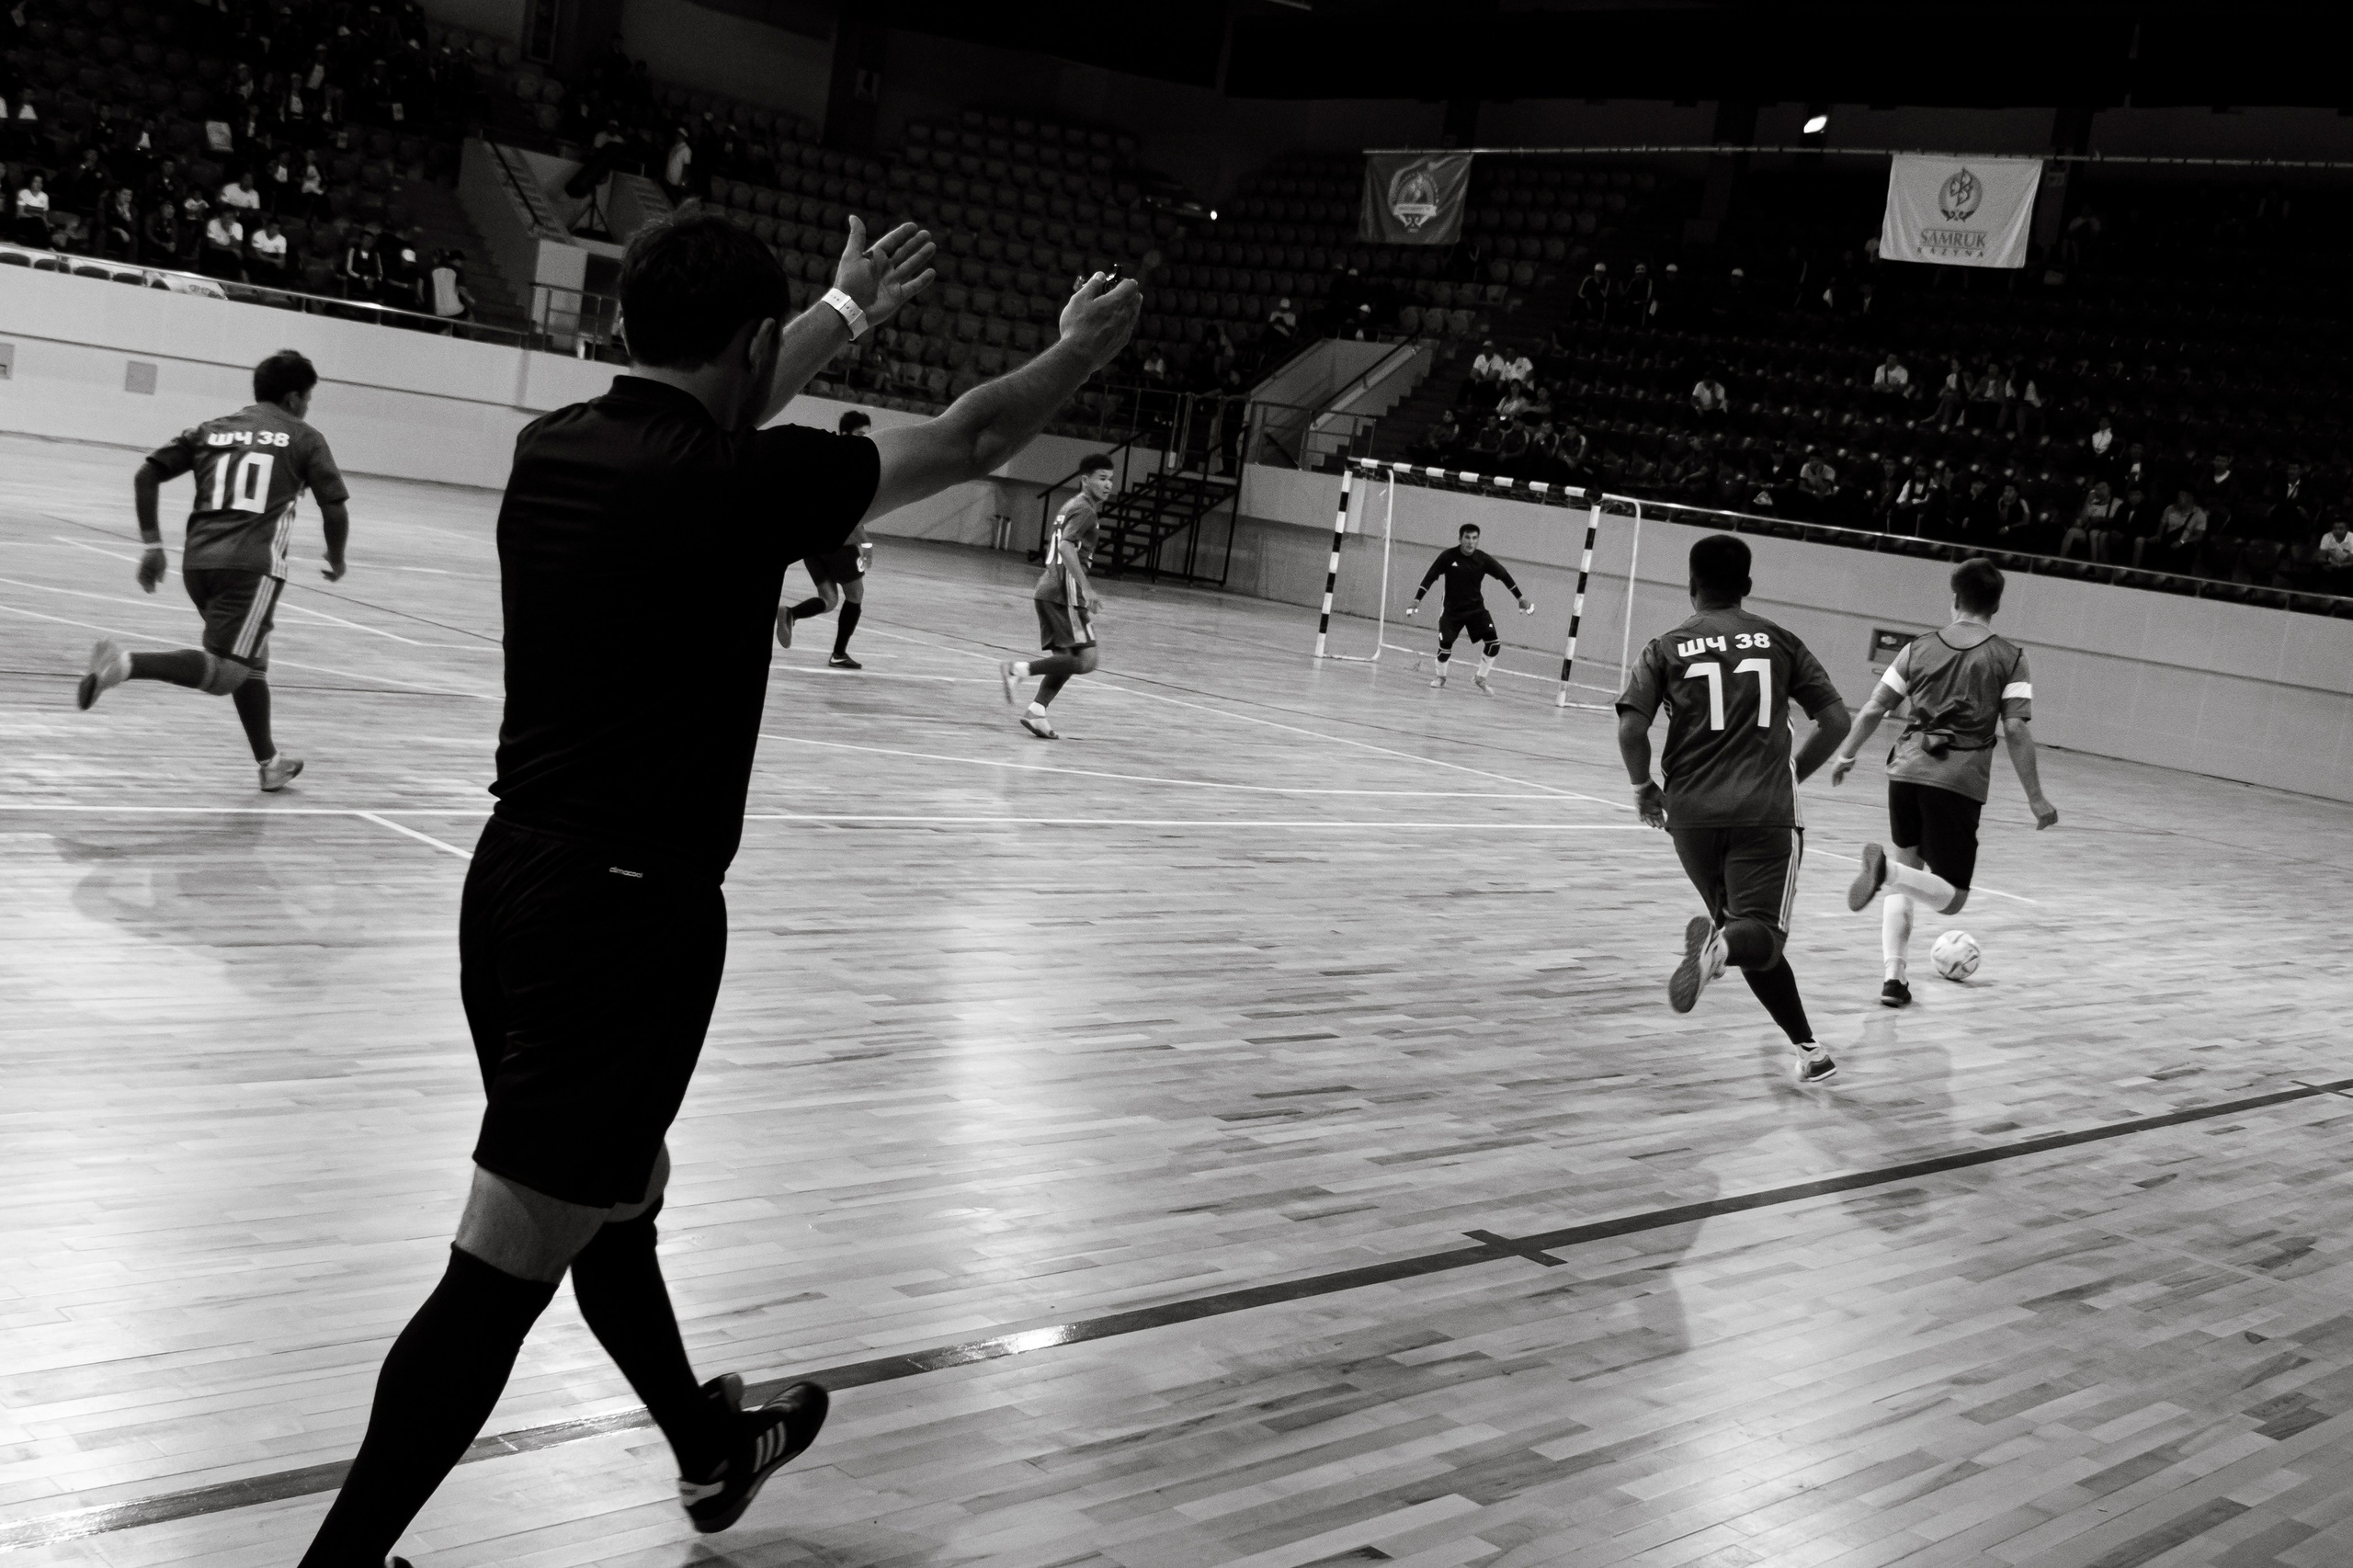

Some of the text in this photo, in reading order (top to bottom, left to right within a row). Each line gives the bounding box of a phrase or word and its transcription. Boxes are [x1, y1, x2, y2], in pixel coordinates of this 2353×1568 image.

[1920, 229, 1986, 250] SAMRUK
[257, 430, 290, 448] 38
[211, 451, 275, 514] 10
[1734, 632, 1771, 649] 38
[1684, 658, 1772, 731] 11
